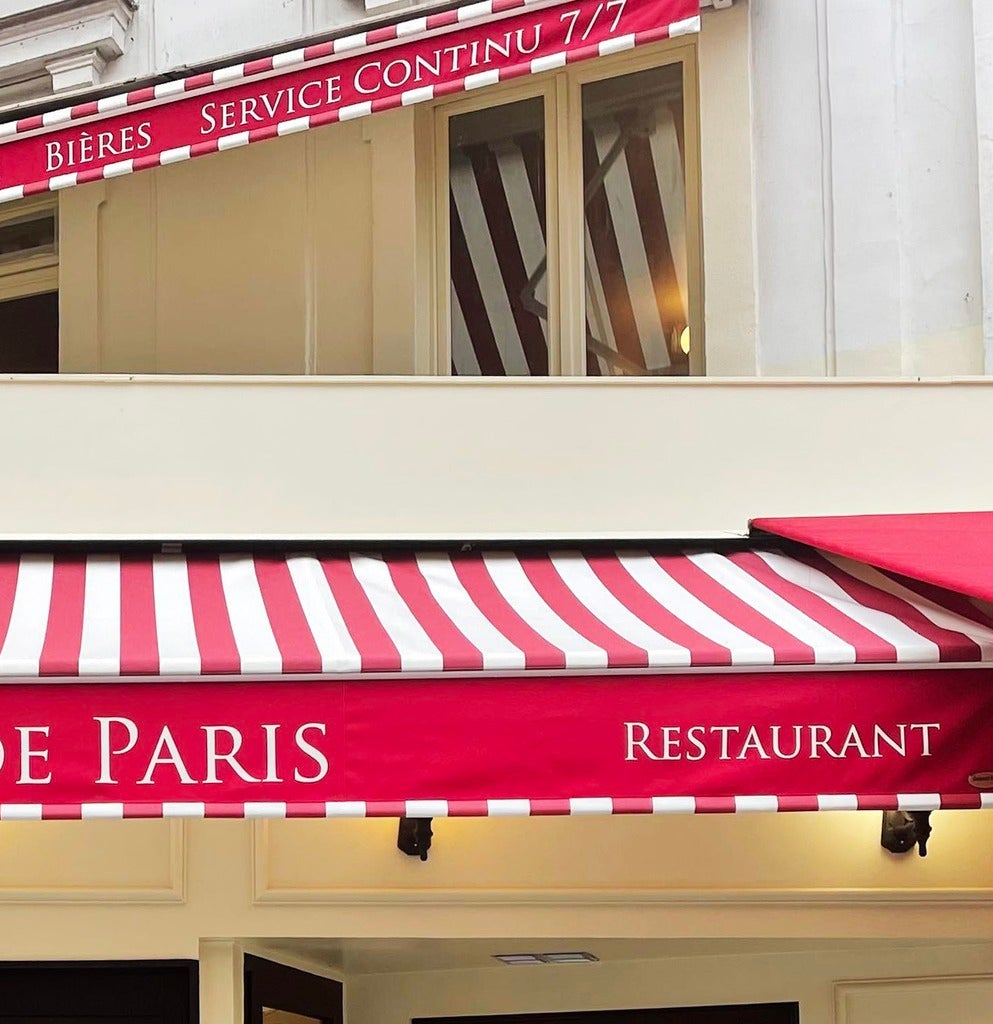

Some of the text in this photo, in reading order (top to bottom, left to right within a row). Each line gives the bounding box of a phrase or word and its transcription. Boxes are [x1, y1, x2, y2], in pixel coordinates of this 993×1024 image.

[45, 121, 153, 173] BIÈRES
[200, 76, 342, 135] SERVICE
[354, 23, 542, 95] CONTINU
[559, 0, 626, 45] 7/7
[93, 715, 331, 786] PARIS
[624, 721, 941, 761] RESTAURANT
